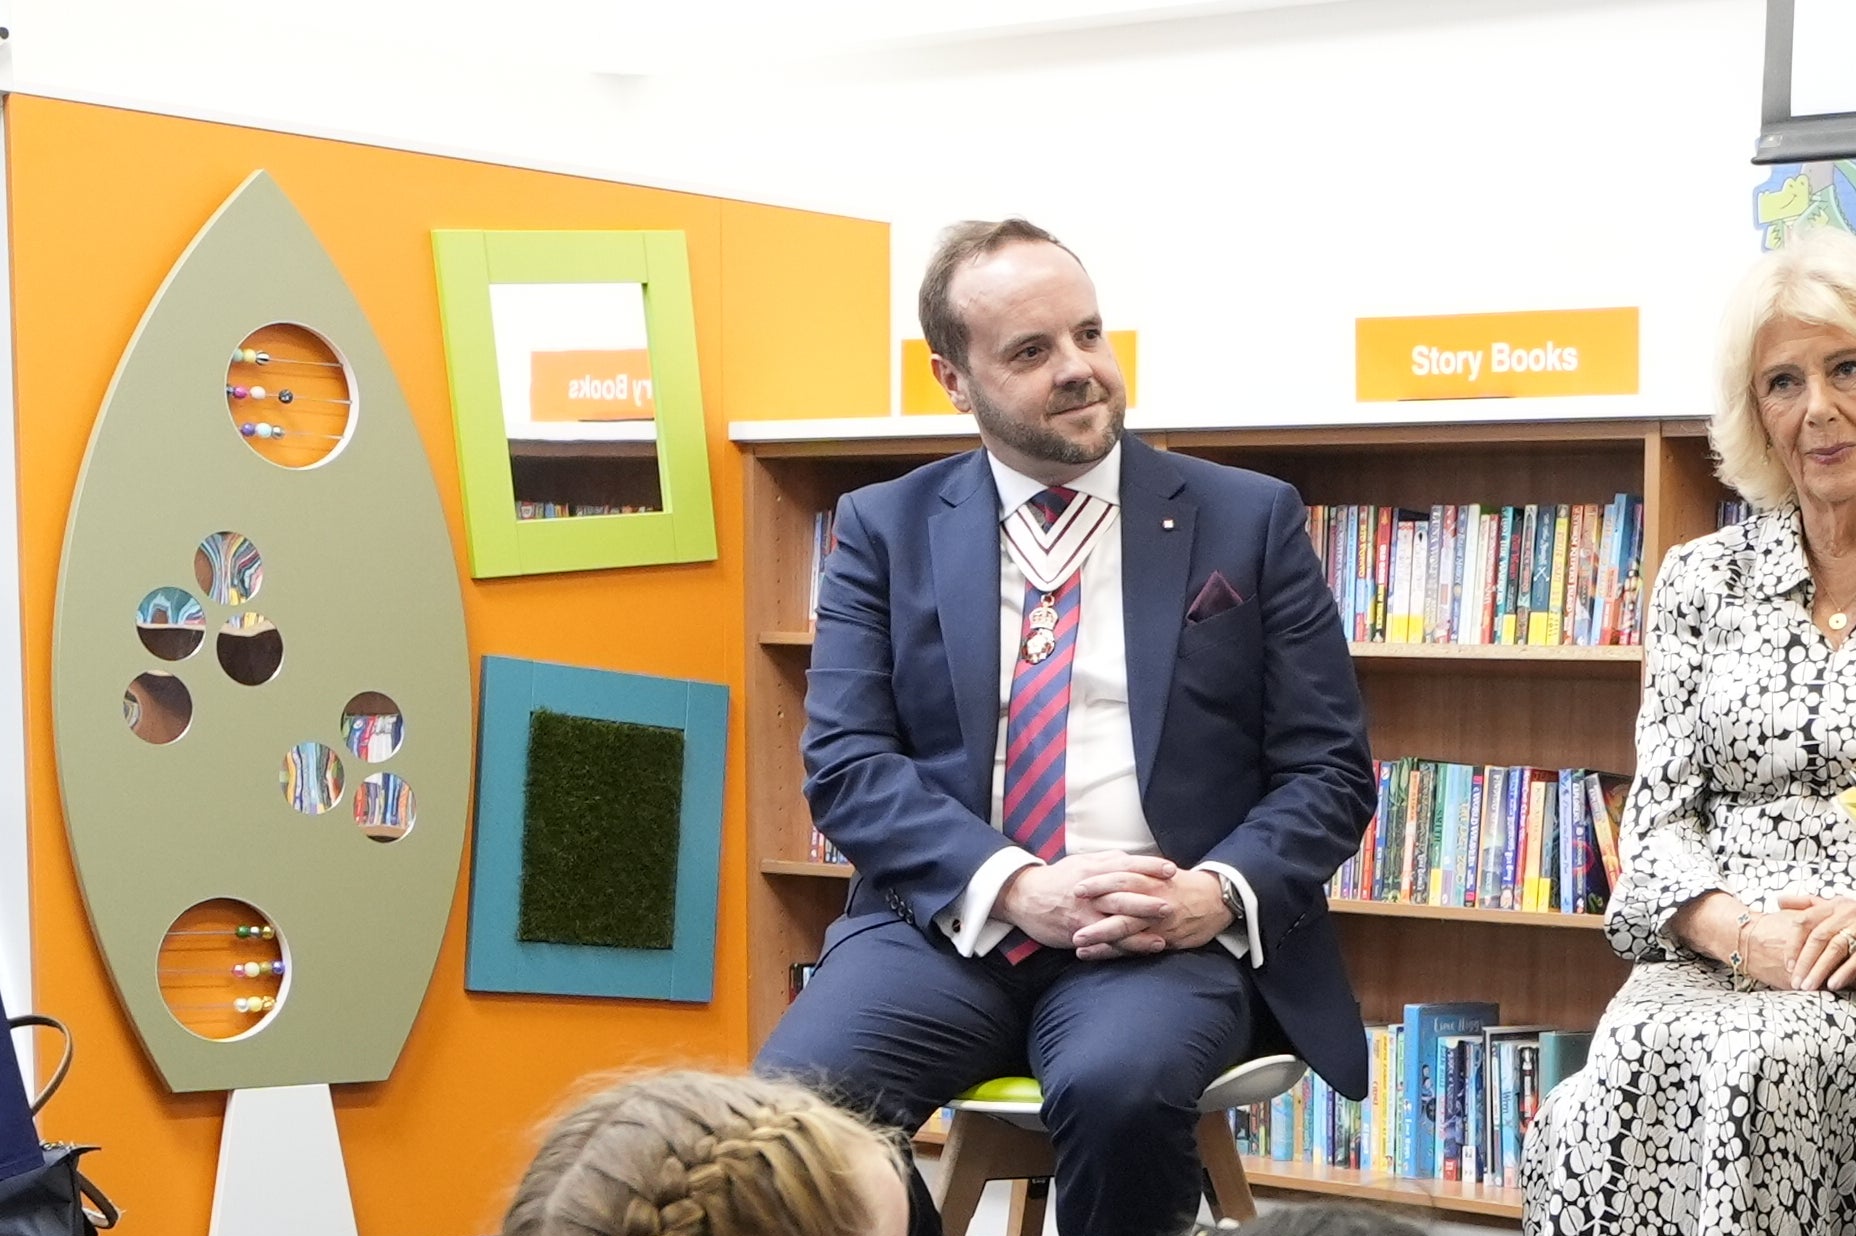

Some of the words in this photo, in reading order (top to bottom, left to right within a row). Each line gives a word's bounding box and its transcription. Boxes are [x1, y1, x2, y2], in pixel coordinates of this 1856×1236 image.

[1412, 345, 1483, 382] Story
[1491, 340, 1578, 372] Books
[1502, 1091, 1512, 1114] Wren
